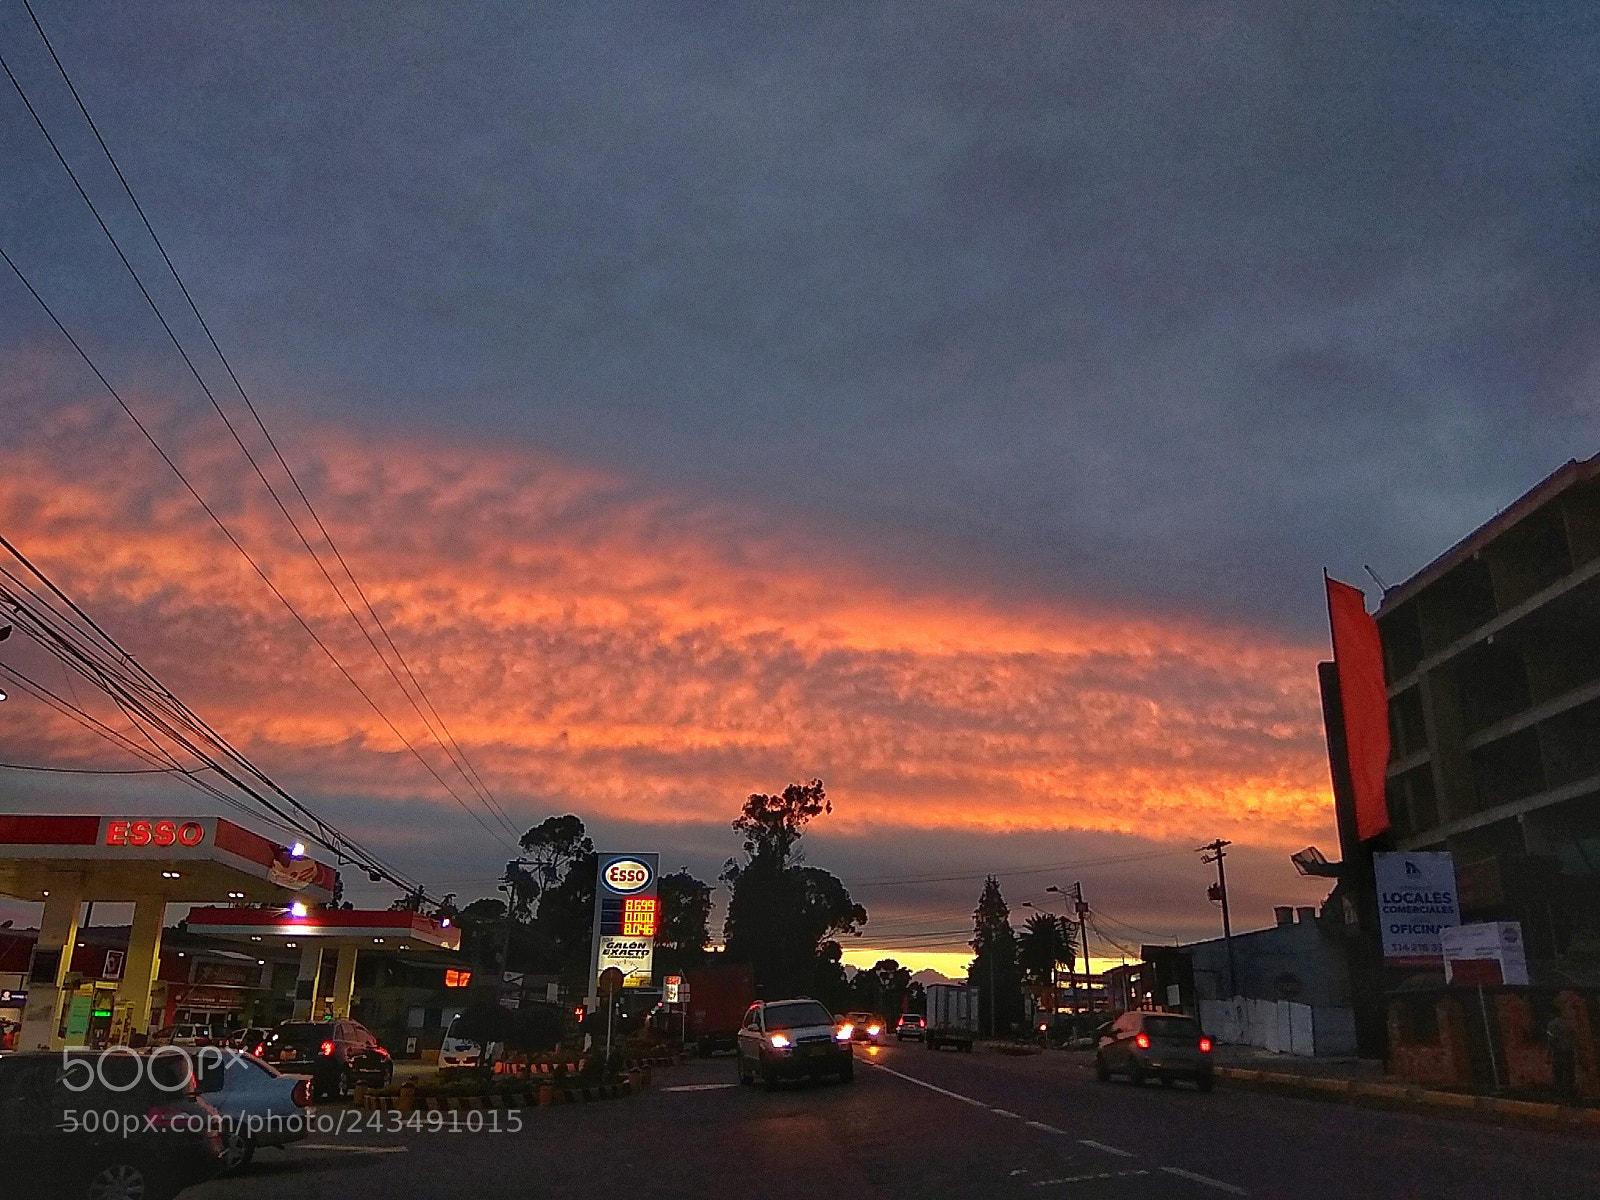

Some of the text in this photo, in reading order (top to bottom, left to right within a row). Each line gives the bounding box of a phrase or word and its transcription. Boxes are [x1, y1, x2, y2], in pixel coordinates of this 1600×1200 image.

[106, 821, 205, 847] ESSO
[610, 866, 645, 882] Esso
[1382, 891, 1452, 904] LOCALES
[1382, 905, 1454, 915] COMERCIALES
[606, 941, 647, 950] GALÓN
[602, 949, 650, 957] EXACTO
